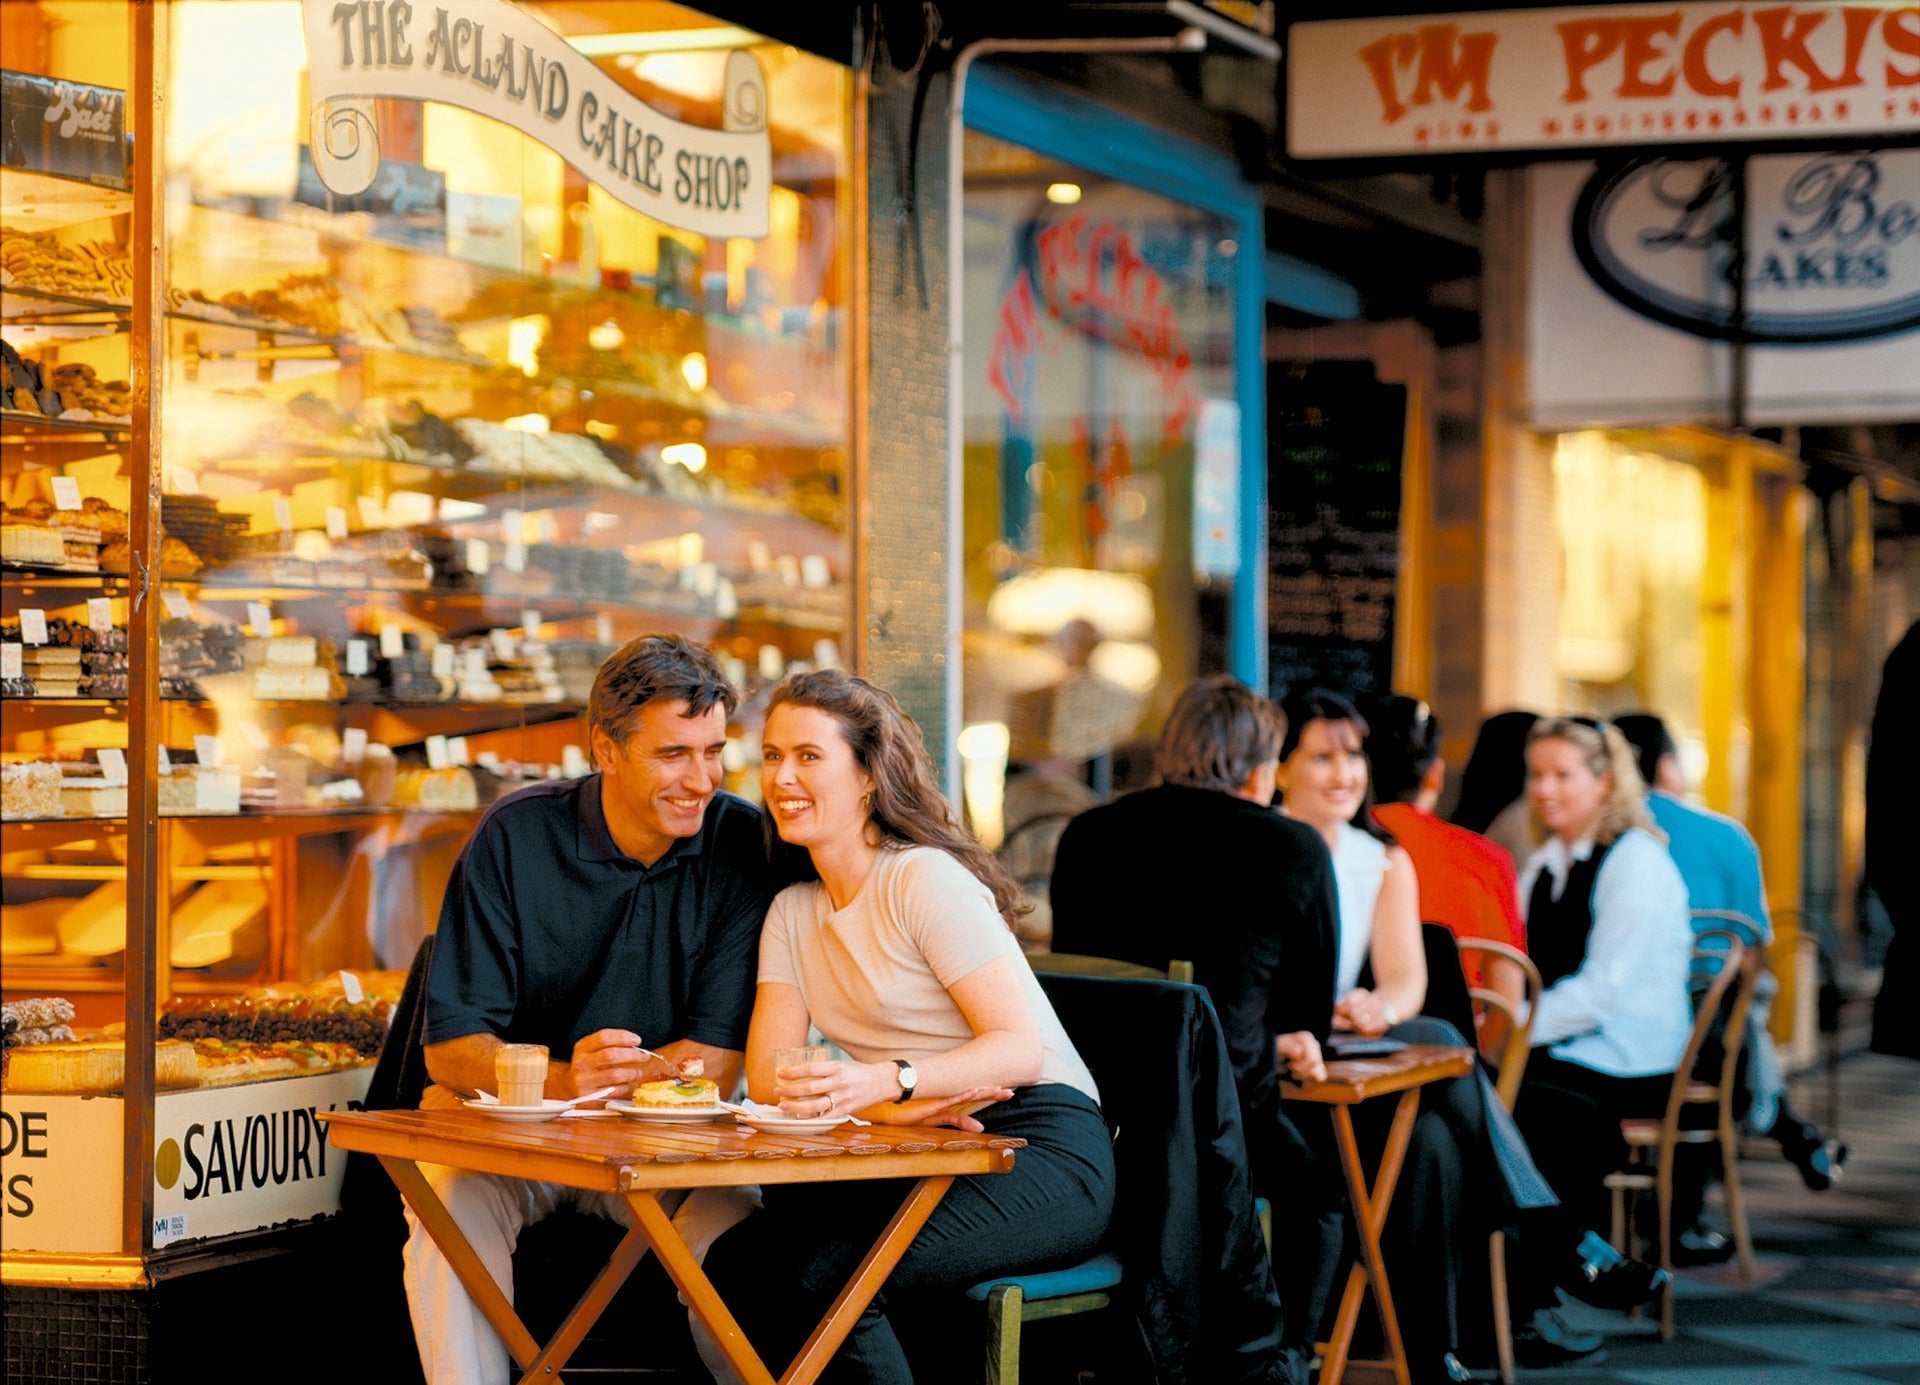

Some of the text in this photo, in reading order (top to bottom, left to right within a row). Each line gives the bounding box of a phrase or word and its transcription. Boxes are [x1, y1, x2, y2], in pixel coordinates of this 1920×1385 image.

[43, 85, 113, 139] Baci
[333, 0, 749, 211] THE ACLAND CAKE SHOP
[1359, 6, 1920, 125] I'M PECKIS
[184, 1103, 336, 1201] SAVOURY
